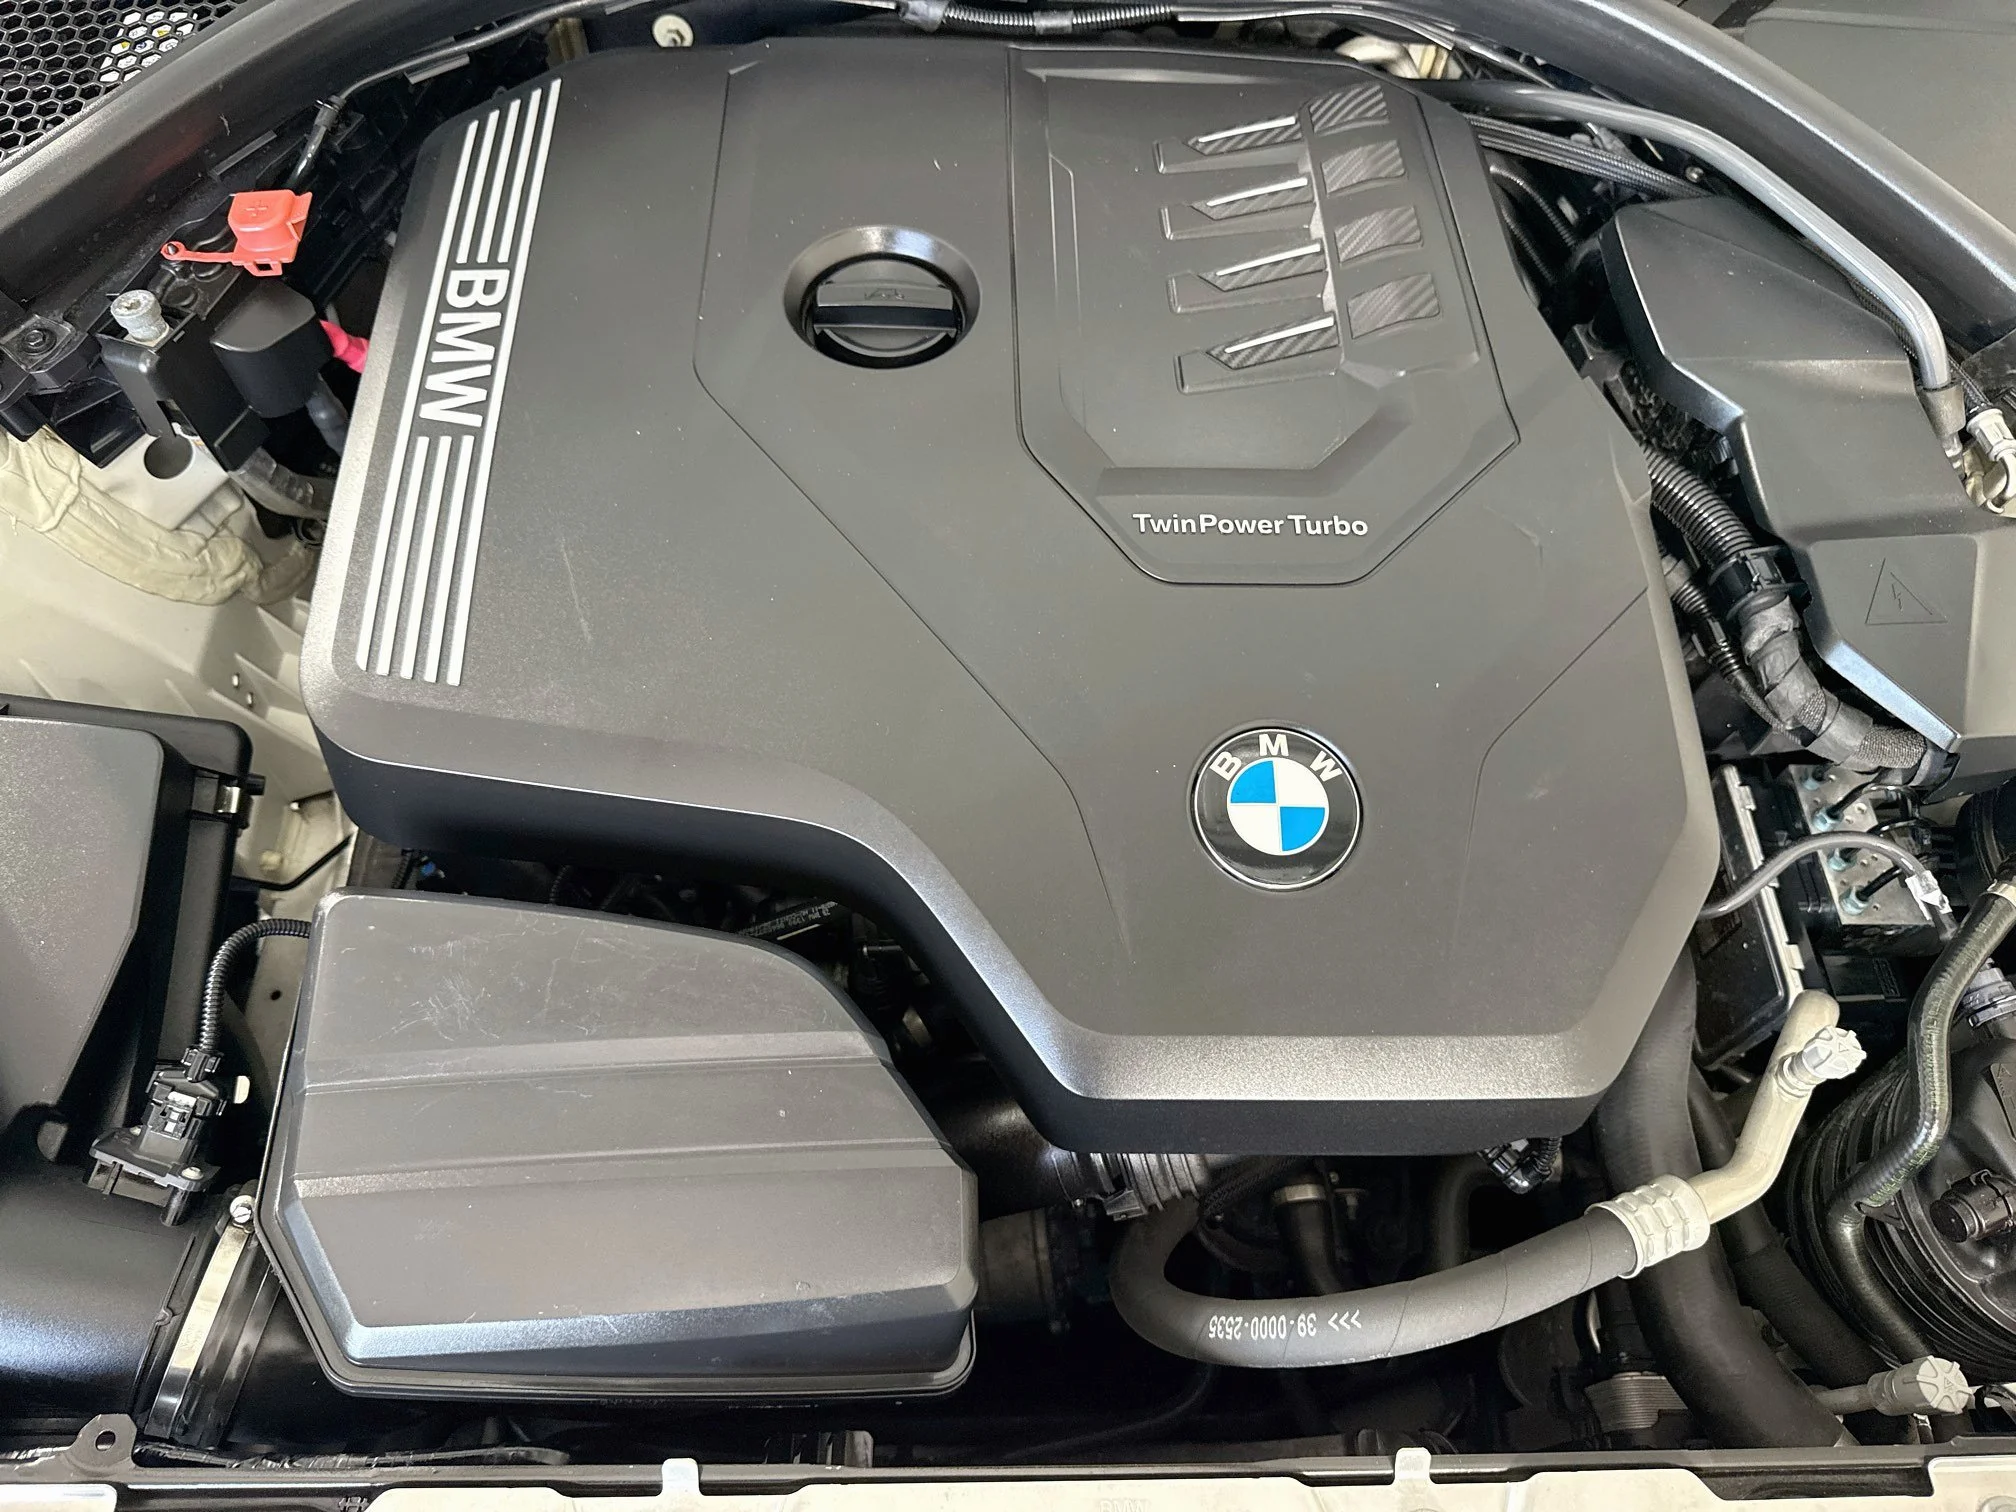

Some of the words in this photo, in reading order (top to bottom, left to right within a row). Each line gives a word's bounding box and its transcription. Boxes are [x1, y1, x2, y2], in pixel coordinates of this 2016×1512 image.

[419, 269, 510, 428] BMW
[1287, 514, 1369, 536] Turbo
[1209, 733, 1343, 783] BMW
